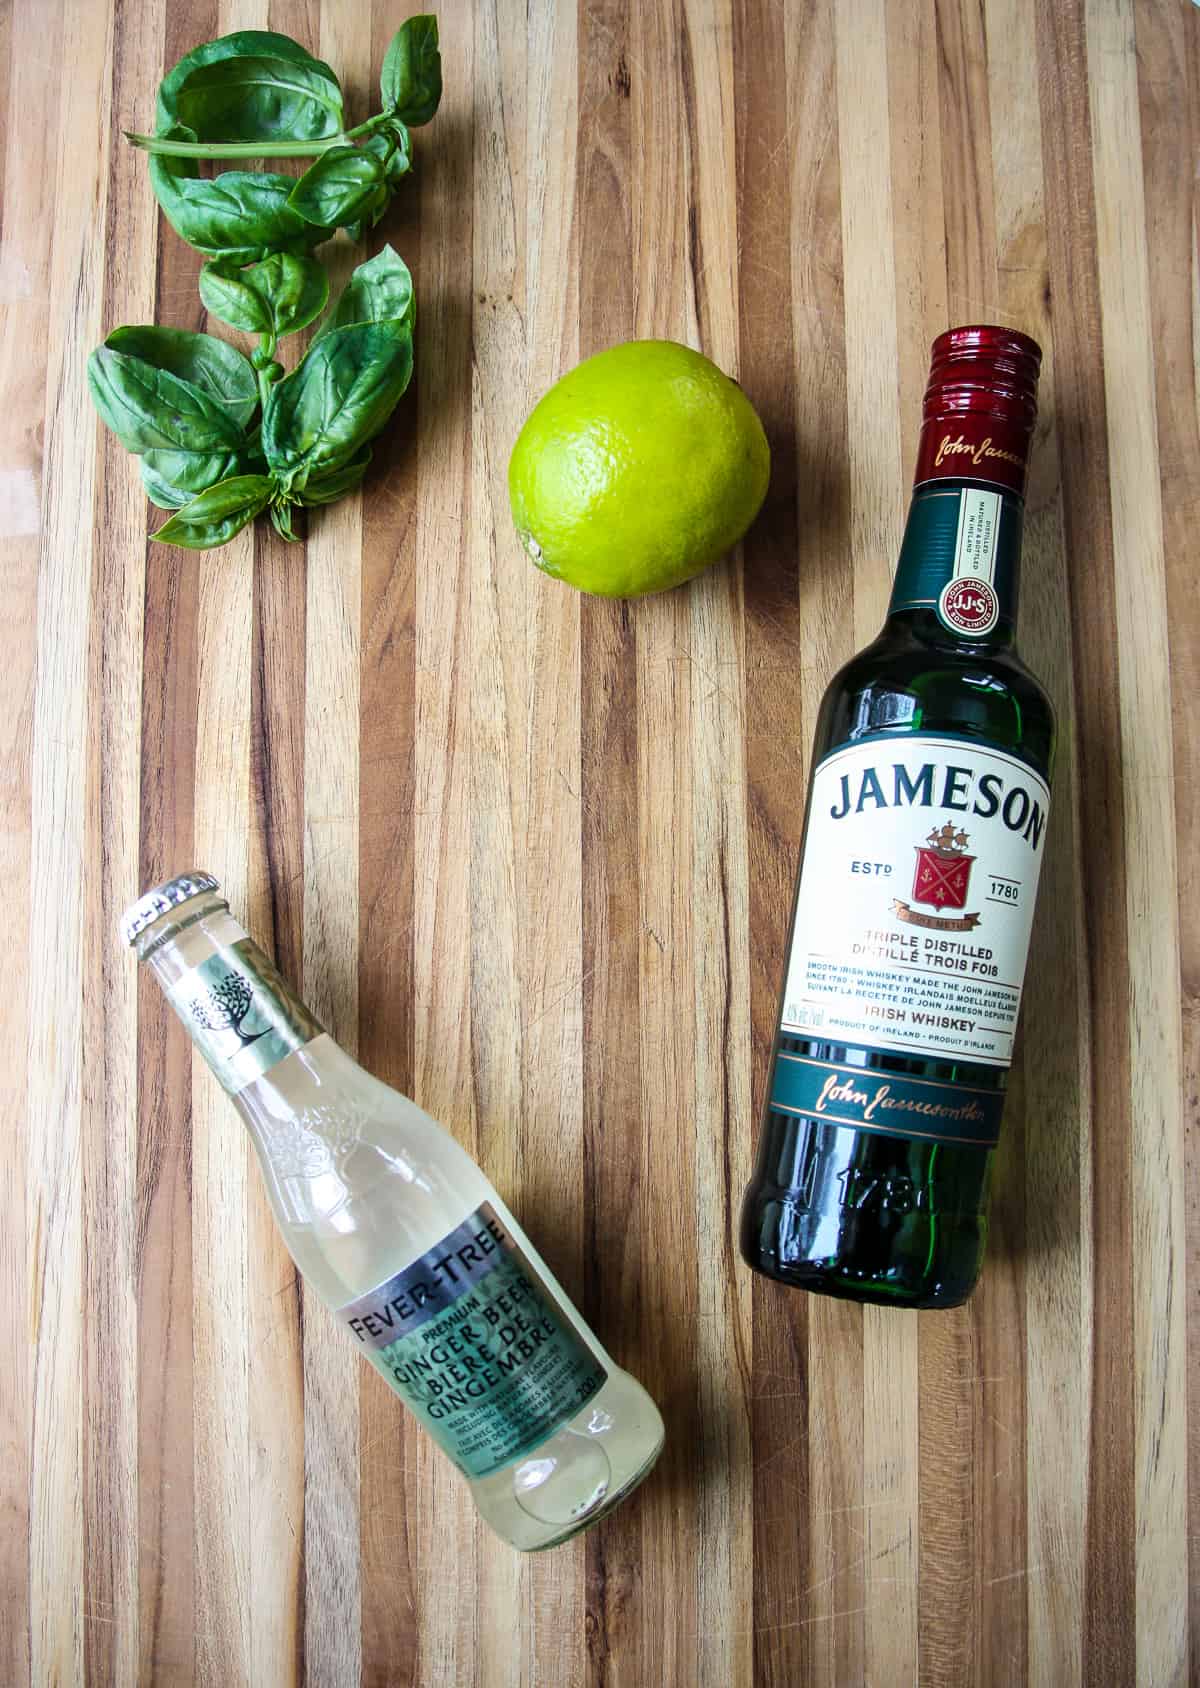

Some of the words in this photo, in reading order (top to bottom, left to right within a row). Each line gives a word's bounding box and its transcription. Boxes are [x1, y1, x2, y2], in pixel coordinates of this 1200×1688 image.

[830, 764, 1045, 851] JAMESON
[991, 882, 1019, 900] 1780
[852, 943, 919, 963] DITILLÉ
[925, 953, 968, 970] TROIS
[971, 962, 998, 977] FOIS
[924, 938, 993, 960] DISTILLED
[857, 978, 901, 992] WHISKEY
[904, 986, 954, 1000] IRLANDAIS
[866, 969, 910, 983] WHISKEY
[913, 976, 940, 988] MADE
[943, 982, 959, 991] THE
[961, 985, 982, 996] JOHN
[855, 990, 898, 1003] RECETTE
[901, 996, 914, 1005] DE
[916, 1000, 942, 1010] JOHN
[944, 1003, 982, 1017] JAMESON
[864, 1005, 906, 1022] IRISH
[912, 1010, 976, 1033] WHISKEY
[882, 1026, 920, 1039] IRELAND
[928, 1033, 962, 1046] PRODUIT
[347, 1220, 504, 1342] FEVER-TREE
[393, 1322, 481, 1385] GINGER
[482, 1276, 533, 1327] BEER
[421, 1298, 481, 1345] PREMIUM
[426, 1342, 495, 1396] BIÈRE
[498, 1314, 530, 1347] DE
[426, 1318, 557, 1420] GINGEMBRE
